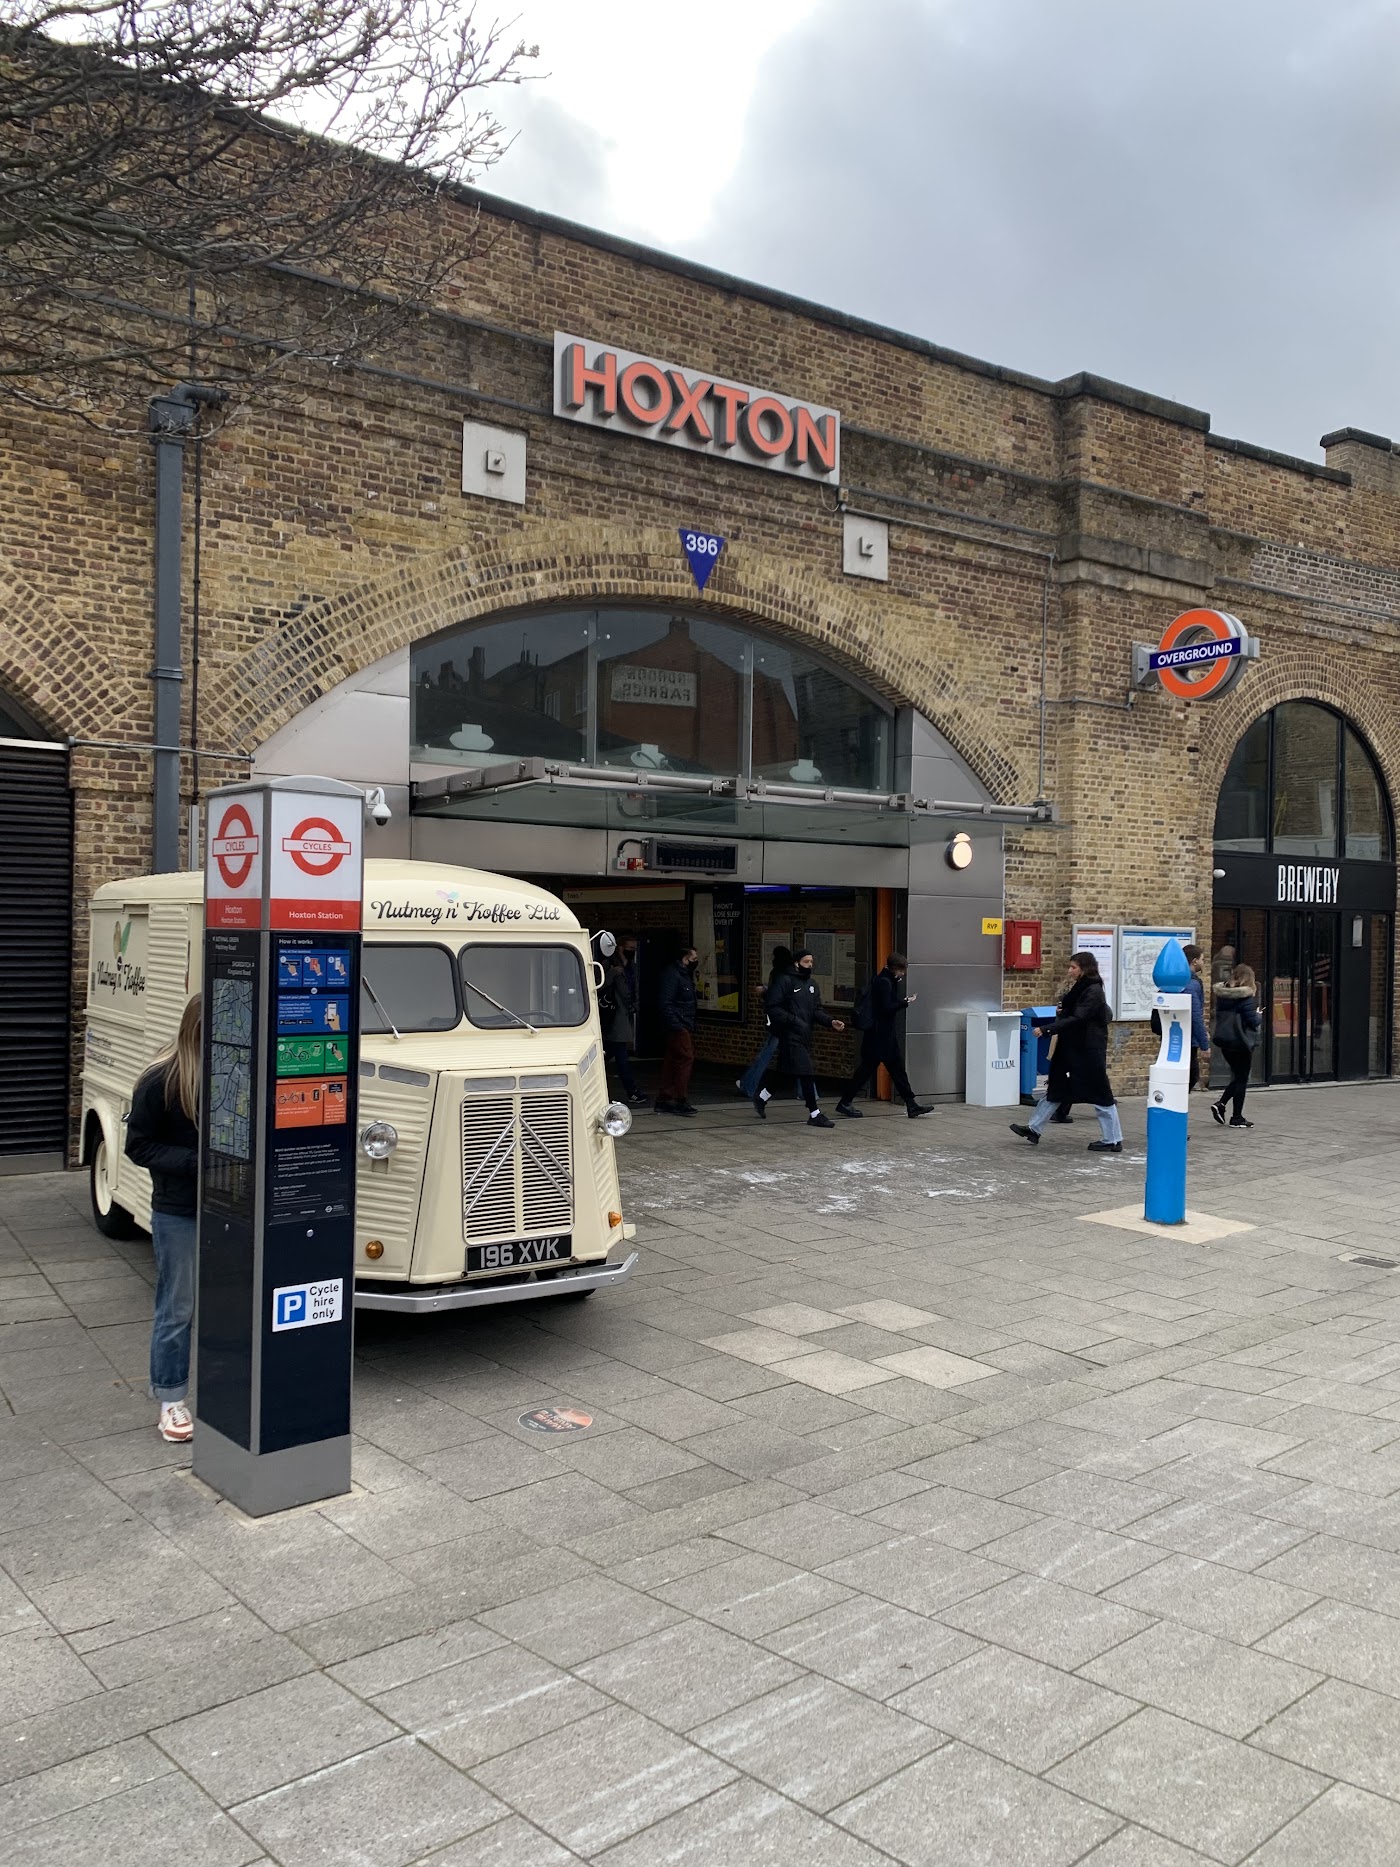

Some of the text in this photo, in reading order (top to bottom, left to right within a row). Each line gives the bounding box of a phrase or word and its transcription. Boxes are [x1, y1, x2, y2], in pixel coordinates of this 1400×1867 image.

[563, 342, 836, 474] HOXTON
[685, 534, 718, 556] 396
[1157, 642, 1232, 666] OVERGROUND
[225, 841, 245, 852] CYCLES
[303, 842, 332, 851] CYCLES
[1277, 864, 1340, 904] BREWERY
[225, 904, 242, 914] Hoxton
[289, 911, 343, 920] Hoxton Station
[370, 900, 443, 925] Nutmeg
[463, 901, 522, 923] Koffee
[525, 904, 561, 921] Ltd
[123, 963, 145, 996] Koffee
[480, 1237, 561, 1269] 196 XVK
[309, 1283, 339, 1297] Cycle
[283, 1294, 303, 1322] P
[313, 1297, 334, 1308] hire
[312, 1308, 335, 1320] only
